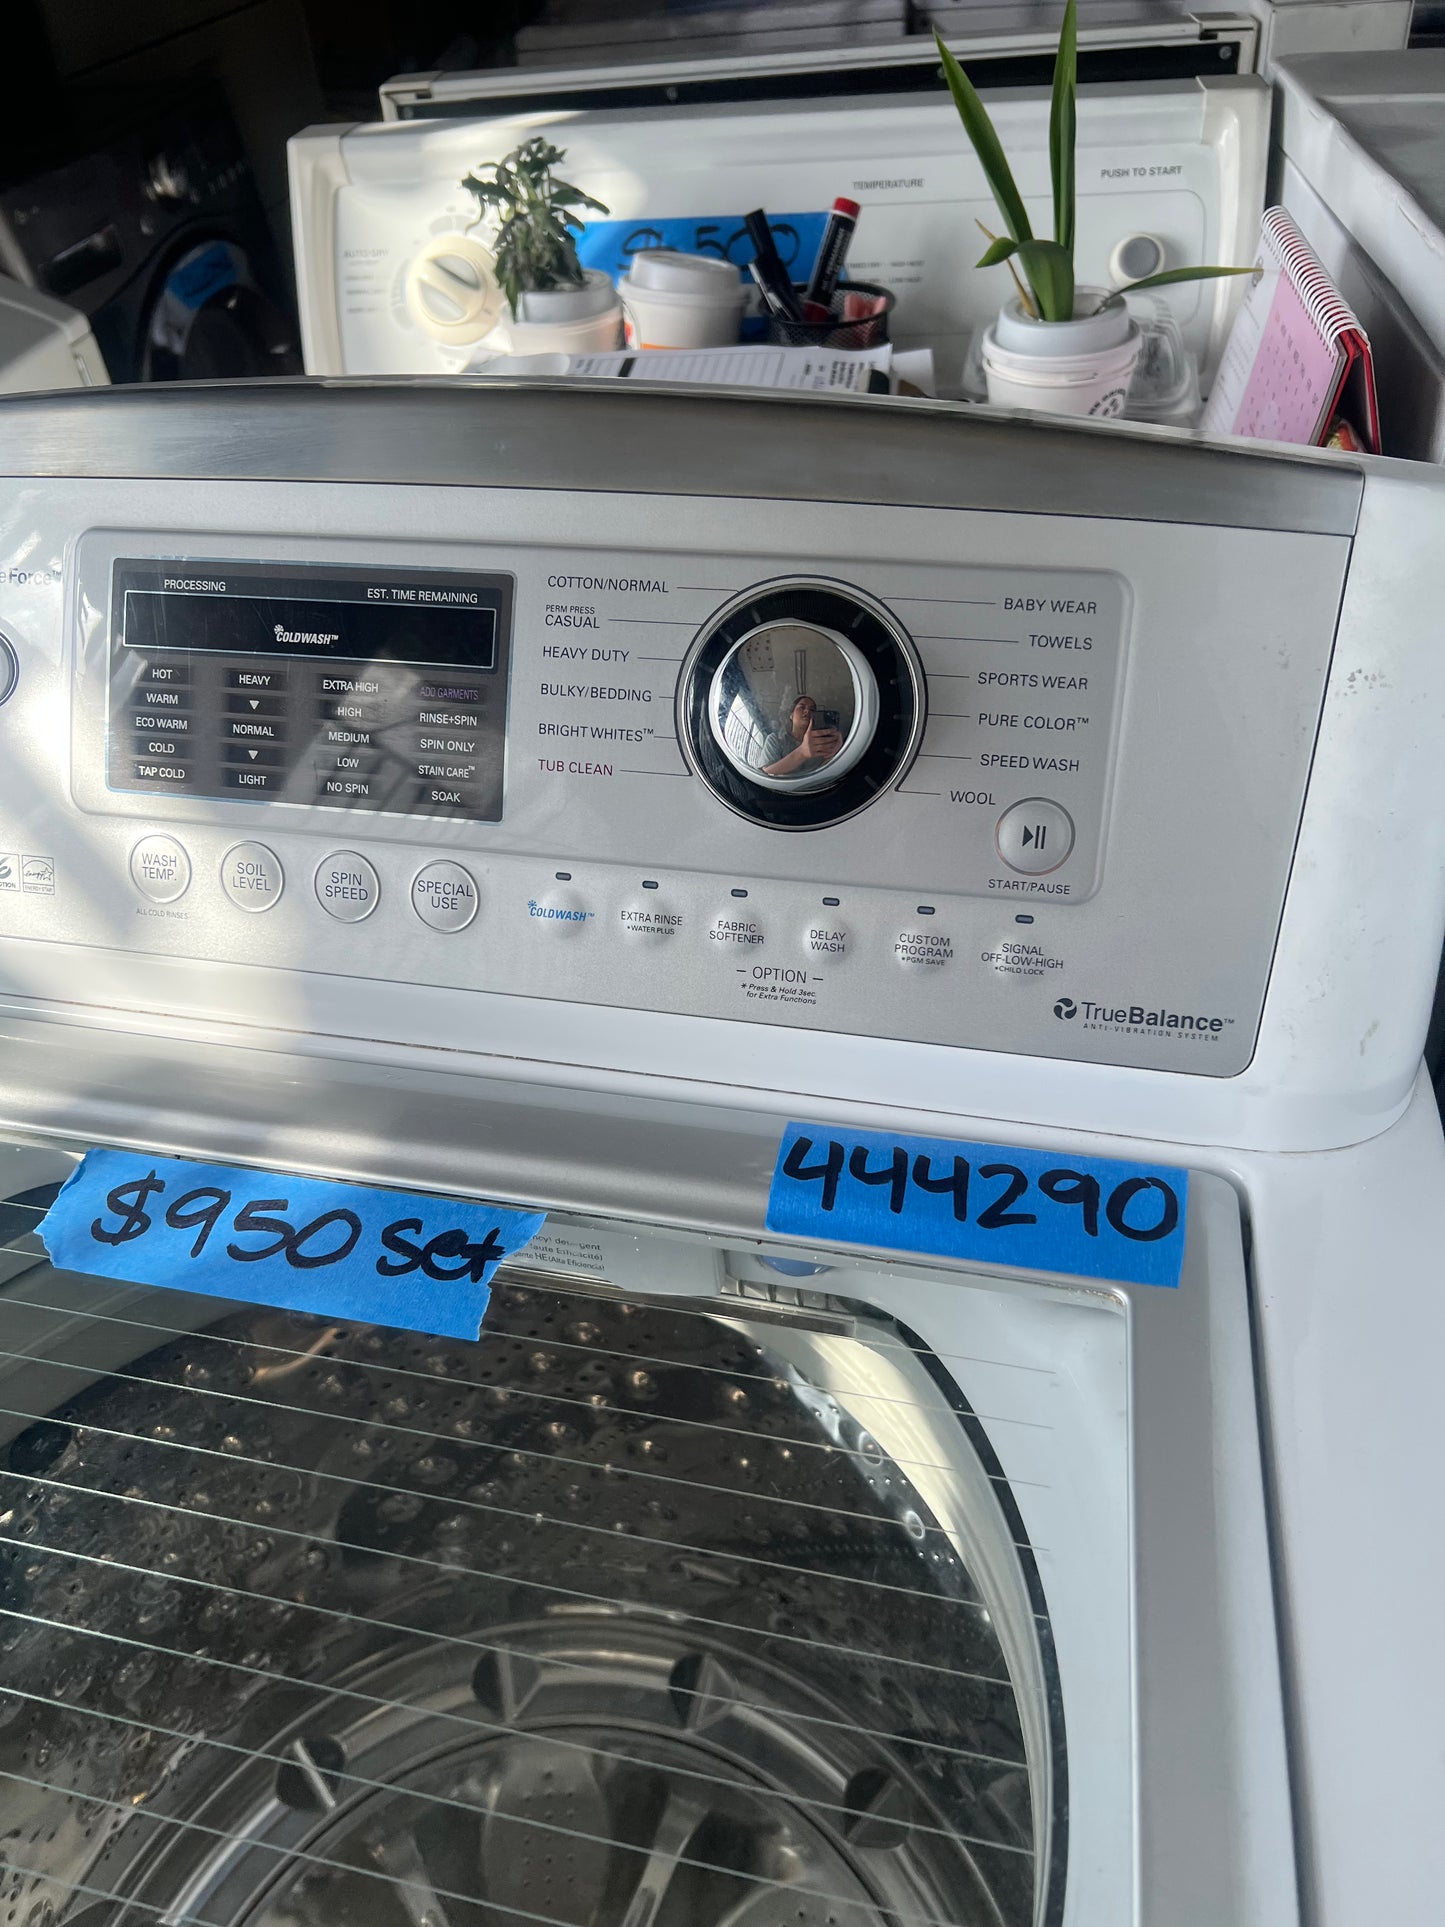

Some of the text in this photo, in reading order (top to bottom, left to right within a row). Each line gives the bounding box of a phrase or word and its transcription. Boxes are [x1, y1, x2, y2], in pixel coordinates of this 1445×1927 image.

[1100, 165, 1182, 178] PUSH TO START
[853, 178, 925, 190] TEMPERATURE
[164, 579, 227, 592] PROCESSING
[547, 575, 669, 593] COTTON/NORMAL
[367, 588, 478, 604] EST. TIME REMAINING
[545, 604, 595, 615] PERM PRESS
[1004, 598, 1097, 614] BABY WEAR
[545, 614, 600, 629] CASUAL
[1029, 634, 1093, 651] TOWELS
[543, 646, 630, 663] HEAVY DUTY
[152, 668, 173, 680] HOT
[238, 674, 271, 687] HEAVY
[977, 671, 1088, 690] SPORTS WEAR
[322, 679, 379, 694] EXTRA HIGH
[420, 686, 479, 700] ADD GARMENTS
[541, 683, 652, 703] BULKY/BEDDING
[146, 692, 179, 705] WARM
[337, 706, 362, 718] HIGH
[135, 716, 188, 730] ECO WARM
[419, 712, 478, 727] RINSE+SPIN
[978, 713, 1020, 727] PURE
[232, 723, 275, 737] NORMAL
[539, 723, 588, 738] BRIGHT
[328, 731, 370, 744] MEDIUM
[148, 742, 175, 754] COLD
[420, 738, 475, 753] SPIN ONLY
[337, 757, 359, 769] LOW
[538, 759, 613, 776] TUB CLEAN
[980, 753, 1080, 773] SPEED WASH
[138, 765, 186, 779] TAP COLD
[418, 765, 445, 777] STAIN
[238, 774, 267, 786] LIGHT
[327, 782, 369, 795] NO SPIN
[431, 790, 461, 803] SOAK
[950, 790, 996, 806] WOOL
[142, 852, 177, 867] WASH
[142, 866, 177, 881] TEMP.
[237, 862, 267, 877] SOIL
[232, 876, 271, 891] LEVEL
[331, 871, 362, 886] SPIN
[325, 885, 369, 901] SPEED
[417, 880, 473, 898] SPECIAL
[988, 878, 1071, 895] START/PAUSE
[431, 896, 458, 910] USE
[136, 908, 190, 920] ALL COLD RINSES
[621, 910, 683, 926] EXTRA RINSE
[657, 927, 675, 935] PLUS
[718, 920, 756, 933] FABRIC
[709, 930, 765, 945] SOFTENER
[810, 929, 846, 942] DELAY
[899, 933, 951, 947] CUSTOM
[811, 941, 846, 953] WASH
[894, 943, 954, 959] PROGRAM
[1001, 943, 1045, 957] SIGNAL
[925, 958, 946, 966] SAVE
[980, 952, 1064, 969] OFF-LOW-HIGH
[752, 966, 807, 984] OPTION
[1023, 968, 1045, 976] LOCK
[748, 983, 769, 992] Press
[770, 985, 777, 993] &
[778, 987, 797, 995] Hold
[758, 992, 779, 1001] Extra
[780, 994, 817, 1005] Functions
[1083, 1022, 1220, 1042] ANTI-VIBRATION SYSTEM
[782, 1136, 1179, 1241] 444290
[90, 1169, 363, 1269] $950
